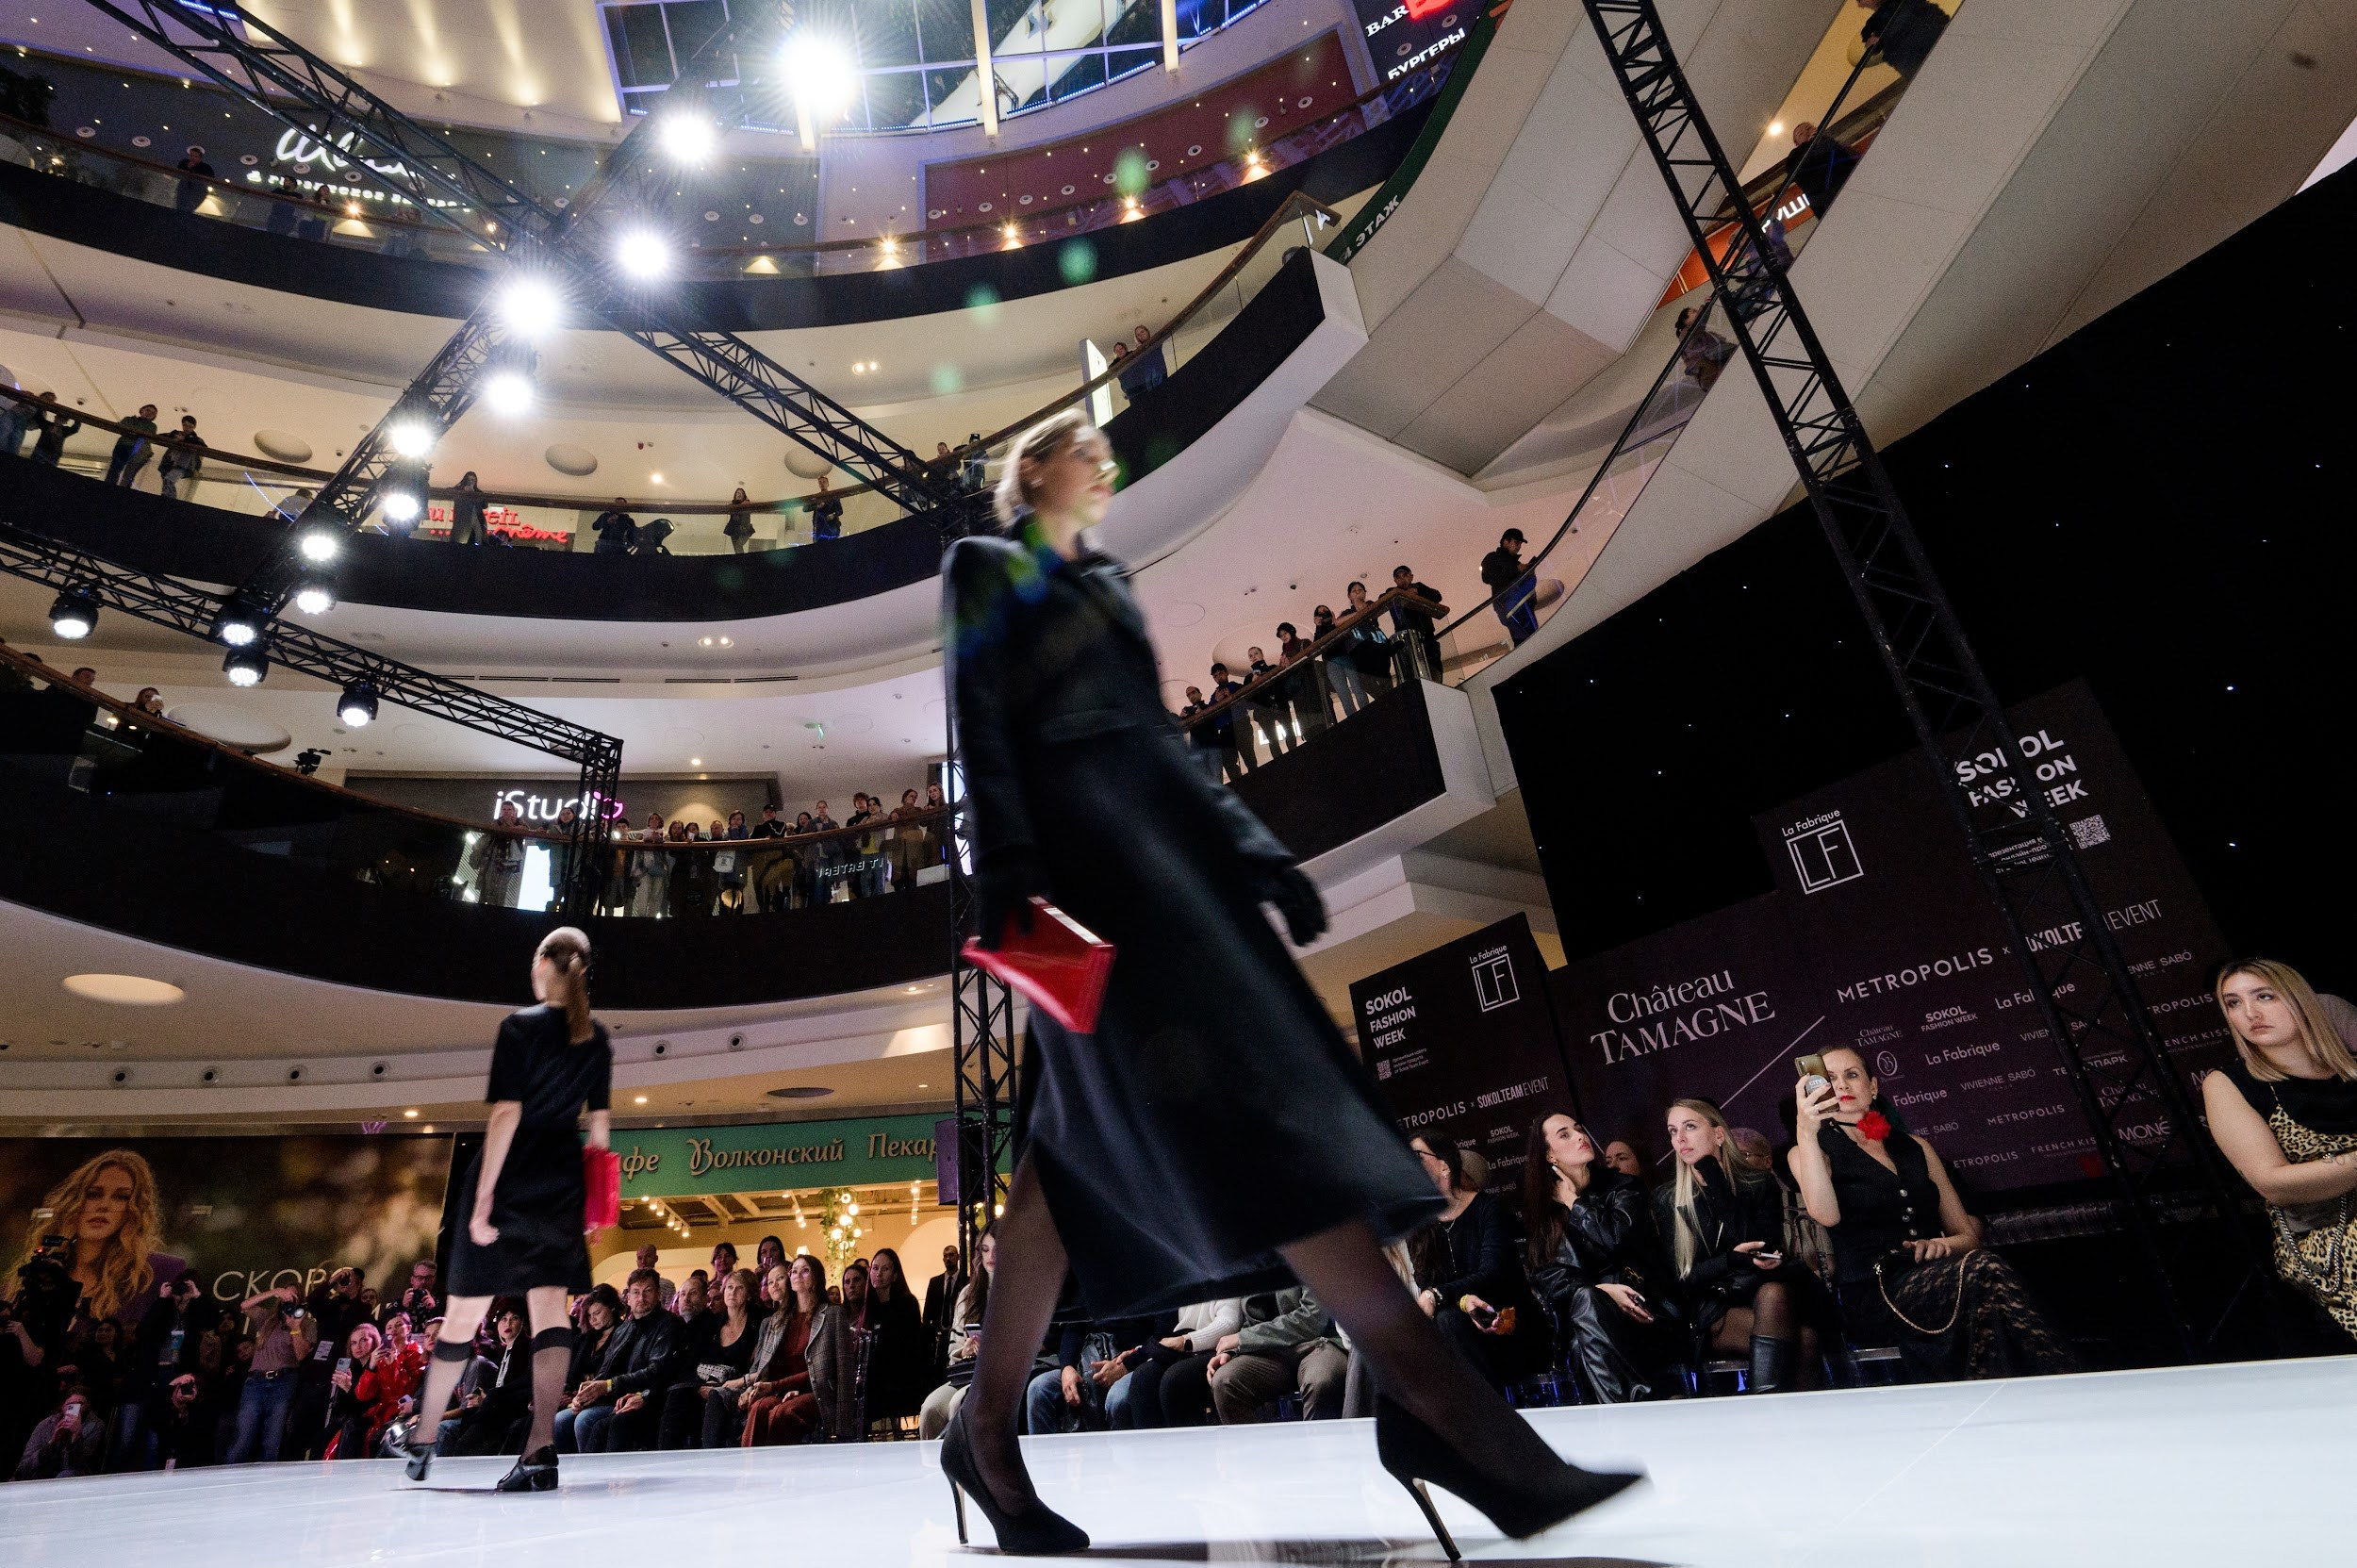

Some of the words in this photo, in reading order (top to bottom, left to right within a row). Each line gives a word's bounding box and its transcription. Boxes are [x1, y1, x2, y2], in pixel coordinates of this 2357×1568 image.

[1365, 5, 1409, 37] BAR
[1387, 27, 1466, 80] БУРГЕРЫ
[1355, 194, 1400, 247] ЭТАЖ
[1781, 826, 1795, 837] La
[1795, 810, 1841, 833] Fabrique
[1470, 955, 1477, 965] La
[1478, 945, 1508, 962] Fabrique
[1837, 948, 1994, 1004] METROPOLIS
[1365, 986, 1412, 1015] SOKOL
[1607, 969, 1735, 1024] Château
[1995, 997, 2013, 1011] La
[1369, 1005, 1416, 1033] FASHION
[1920, 1019, 1954, 1032] FASHION
[1954, 1013, 1978, 1025] WEEK
[1925, 1005, 1968, 1023] SOKOL
[1373, 1028, 1407, 1049] WEEK
[1590, 990, 1776, 1065] TAMAGNE
[1854, 1030, 1904, 1048] TAMAGNE
[1925, 1053, 1941, 1065] La
[1942, 1042, 2001, 1062] Fabrique
[1960, 1075, 2006, 1092] VIVIENNE
[1892, 1089, 1948, 1108] Fabrique
[1986, 1104, 2066, 1127] METROPOLIS
[1490, 1125, 1513, 1137] SOKOL
[2118, 1115, 2171, 1141] MONÉ
[2031, 1140, 2075, 1154] FRENCH
[2077, 1136, 2097, 1147] KIS
[686, 1137, 844, 1177] Волконский
[1953, 1150, 2019, 1169] ETROPOLIS
